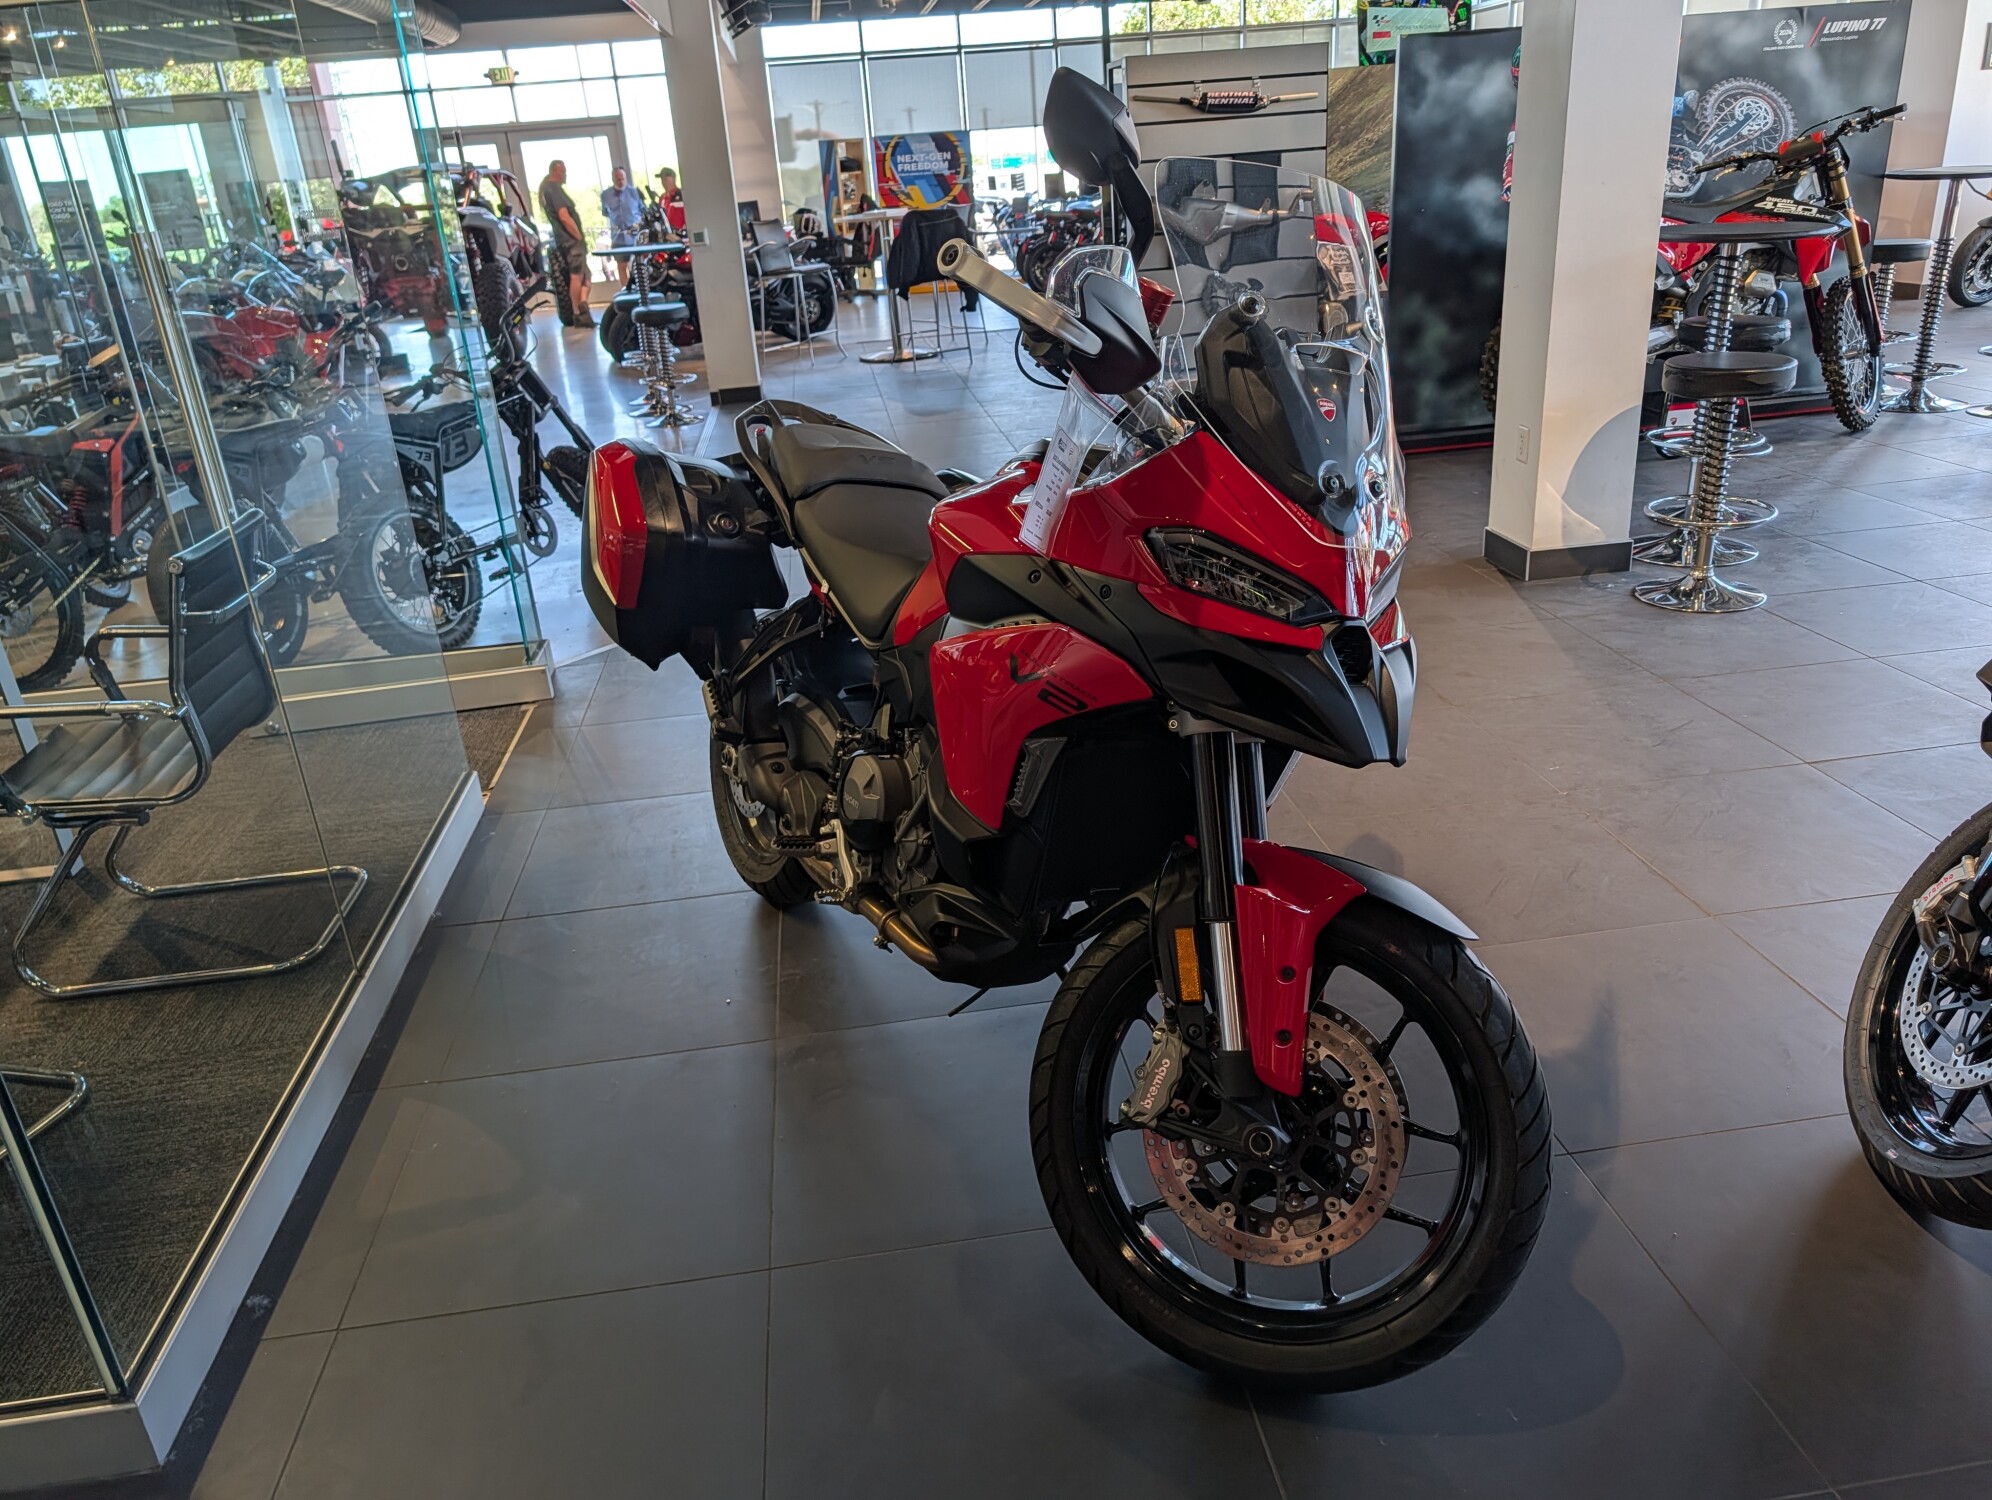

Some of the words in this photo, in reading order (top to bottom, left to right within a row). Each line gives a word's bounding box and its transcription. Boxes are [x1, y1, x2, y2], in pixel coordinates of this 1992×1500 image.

[1823, 19, 1870, 34] LUPINO
[1870, 18, 1887, 30] 77
[1207, 97, 1256, 105] RENTHAL
[897, 152, 951, 162] NEXT-GEN
[898, 161, 949, 172] FREEDOM
[1754, 201, 1818, 214] 450
[415, 450, 432, 462] 73
[1922, 873, 1954, 902] brembo
[1140, 1058, 1171, 1110] brembo
